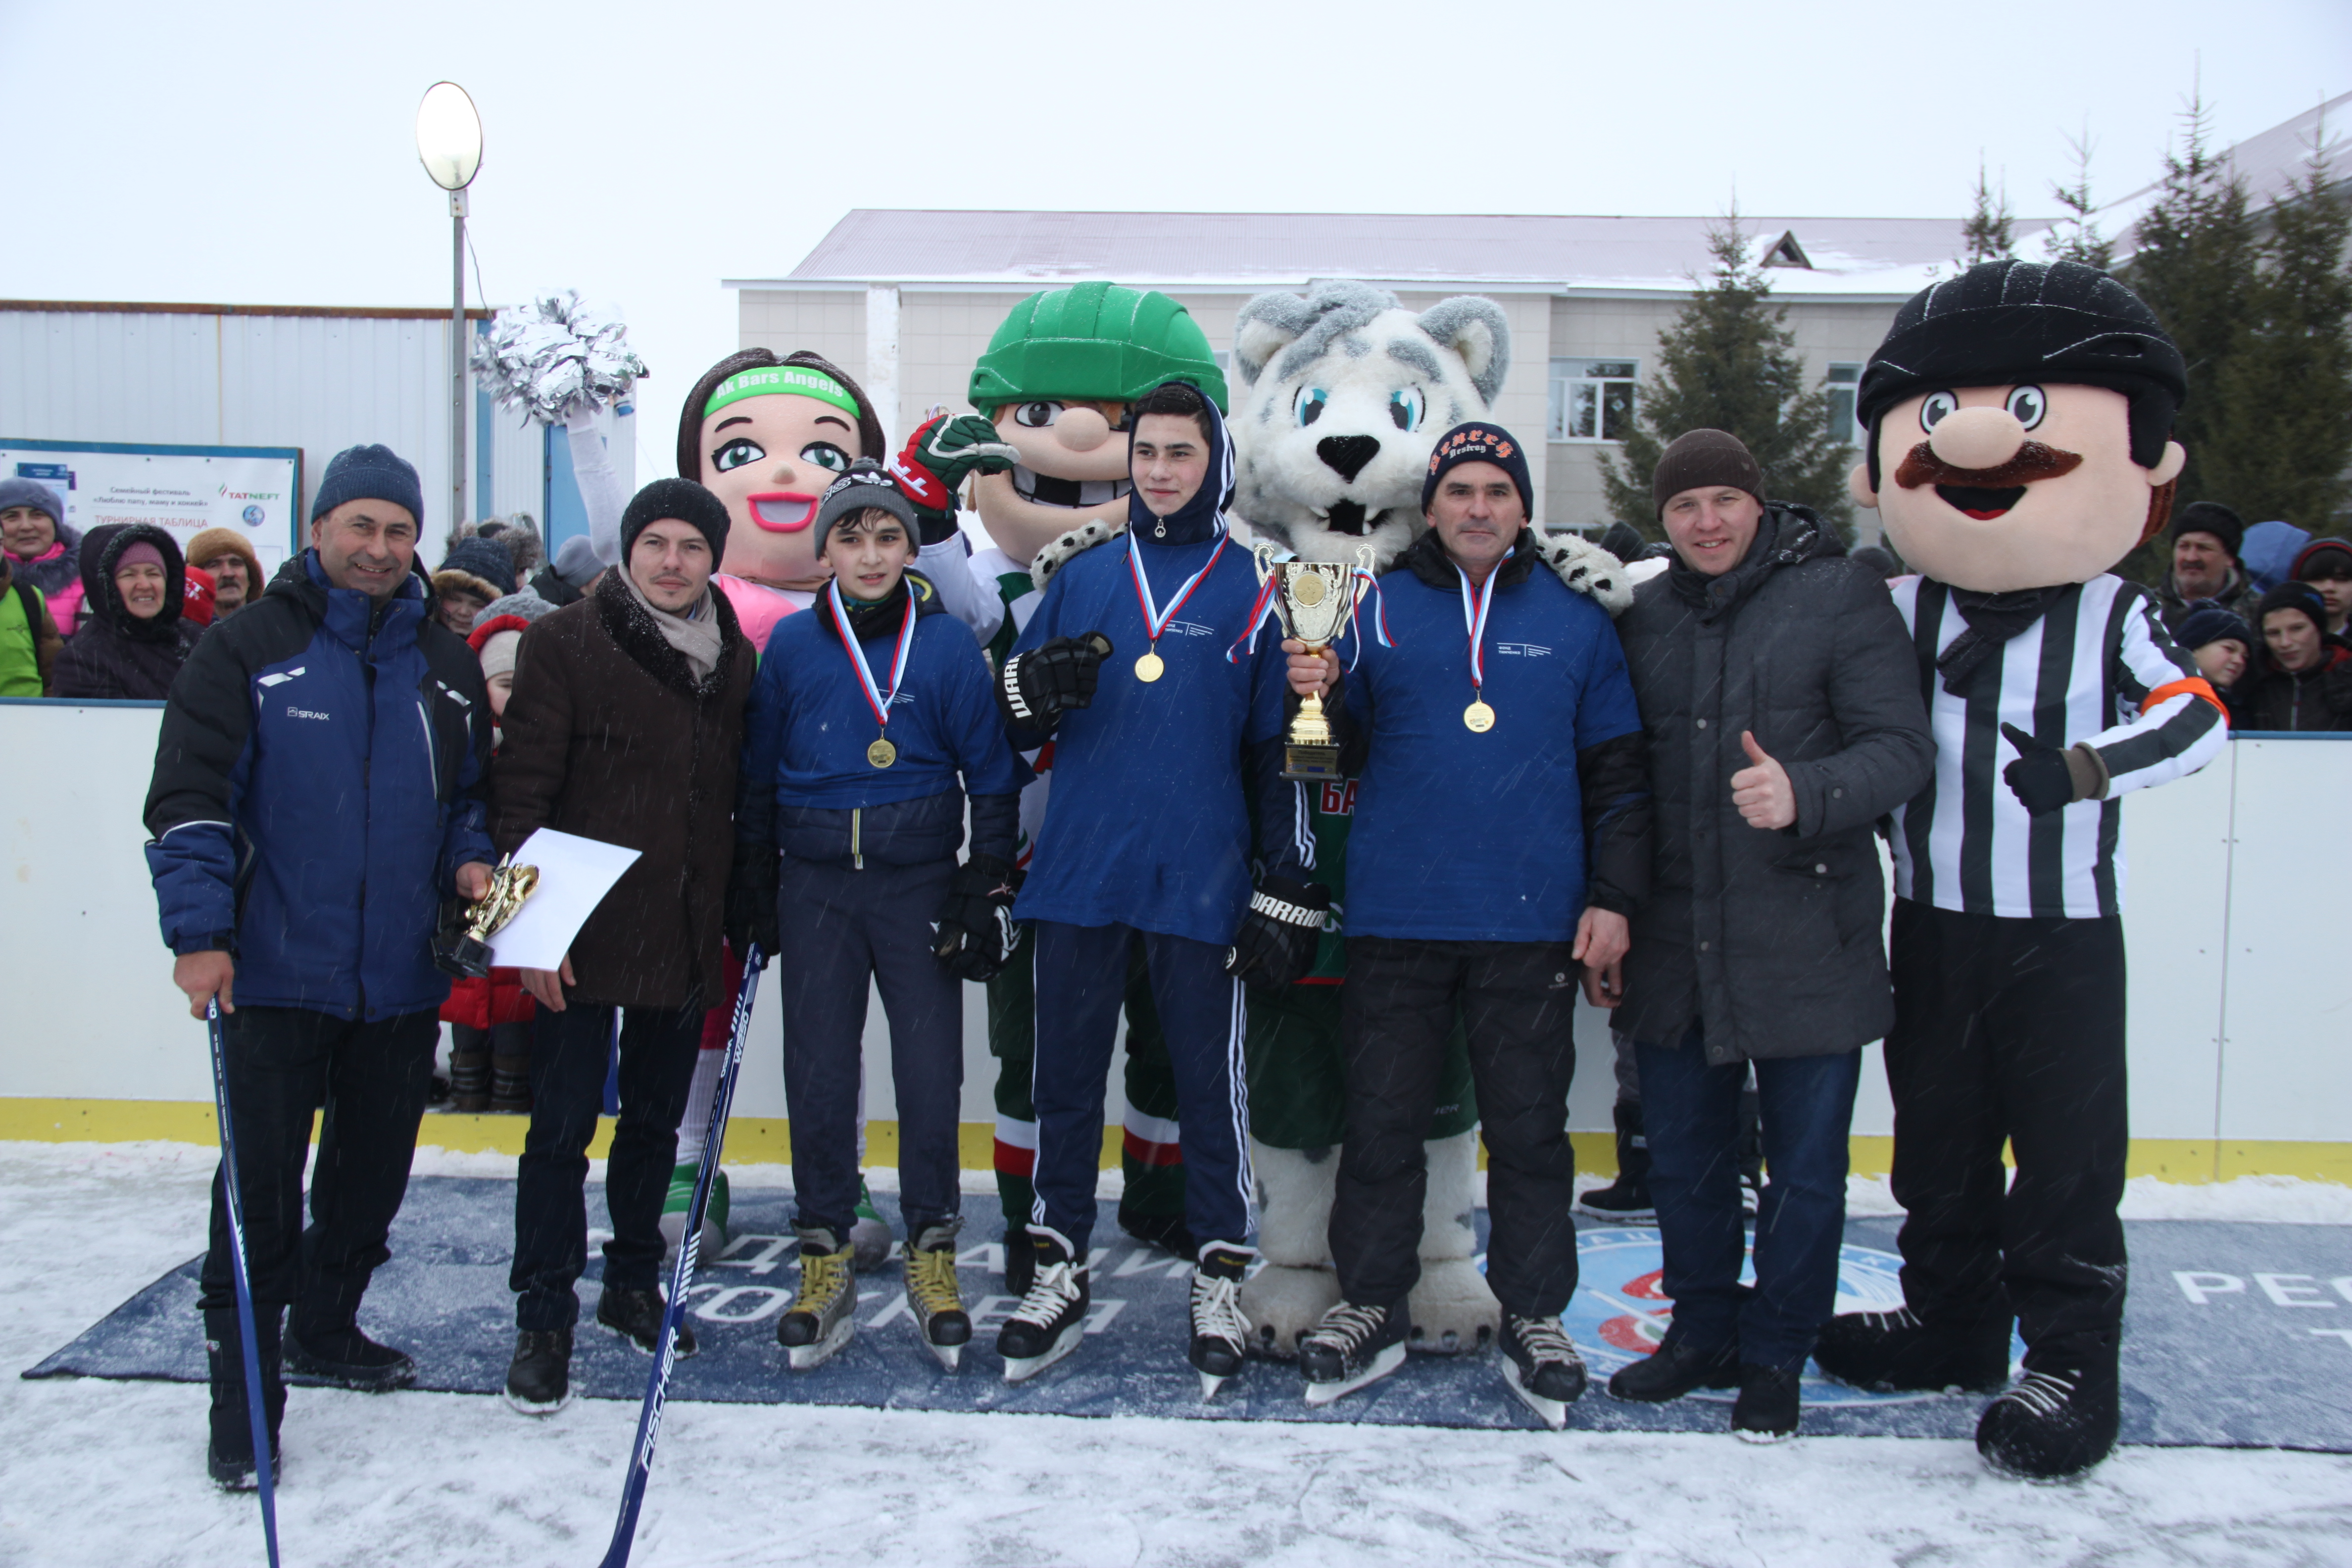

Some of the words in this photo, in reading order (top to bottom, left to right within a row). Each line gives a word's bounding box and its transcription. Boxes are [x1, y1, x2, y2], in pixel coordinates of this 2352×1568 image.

[716, 381, 735, 399] Ak
[738, 373, 779, 389] Bars
[784, 371, 844, 397] Angels
[1449, 443, 1486, 459] Destroy
[95, 515, 156, 525] ТУРНИРНАЯ
[159, 517, 208, 529] ТАБЛИЦА
[298, 710, 330, 721] STRAIX
[734, 1010, 749, 1064] W250
[720, 1038, 734, 1079] W250
[641, 1326, 680, 1473] FISCHER
